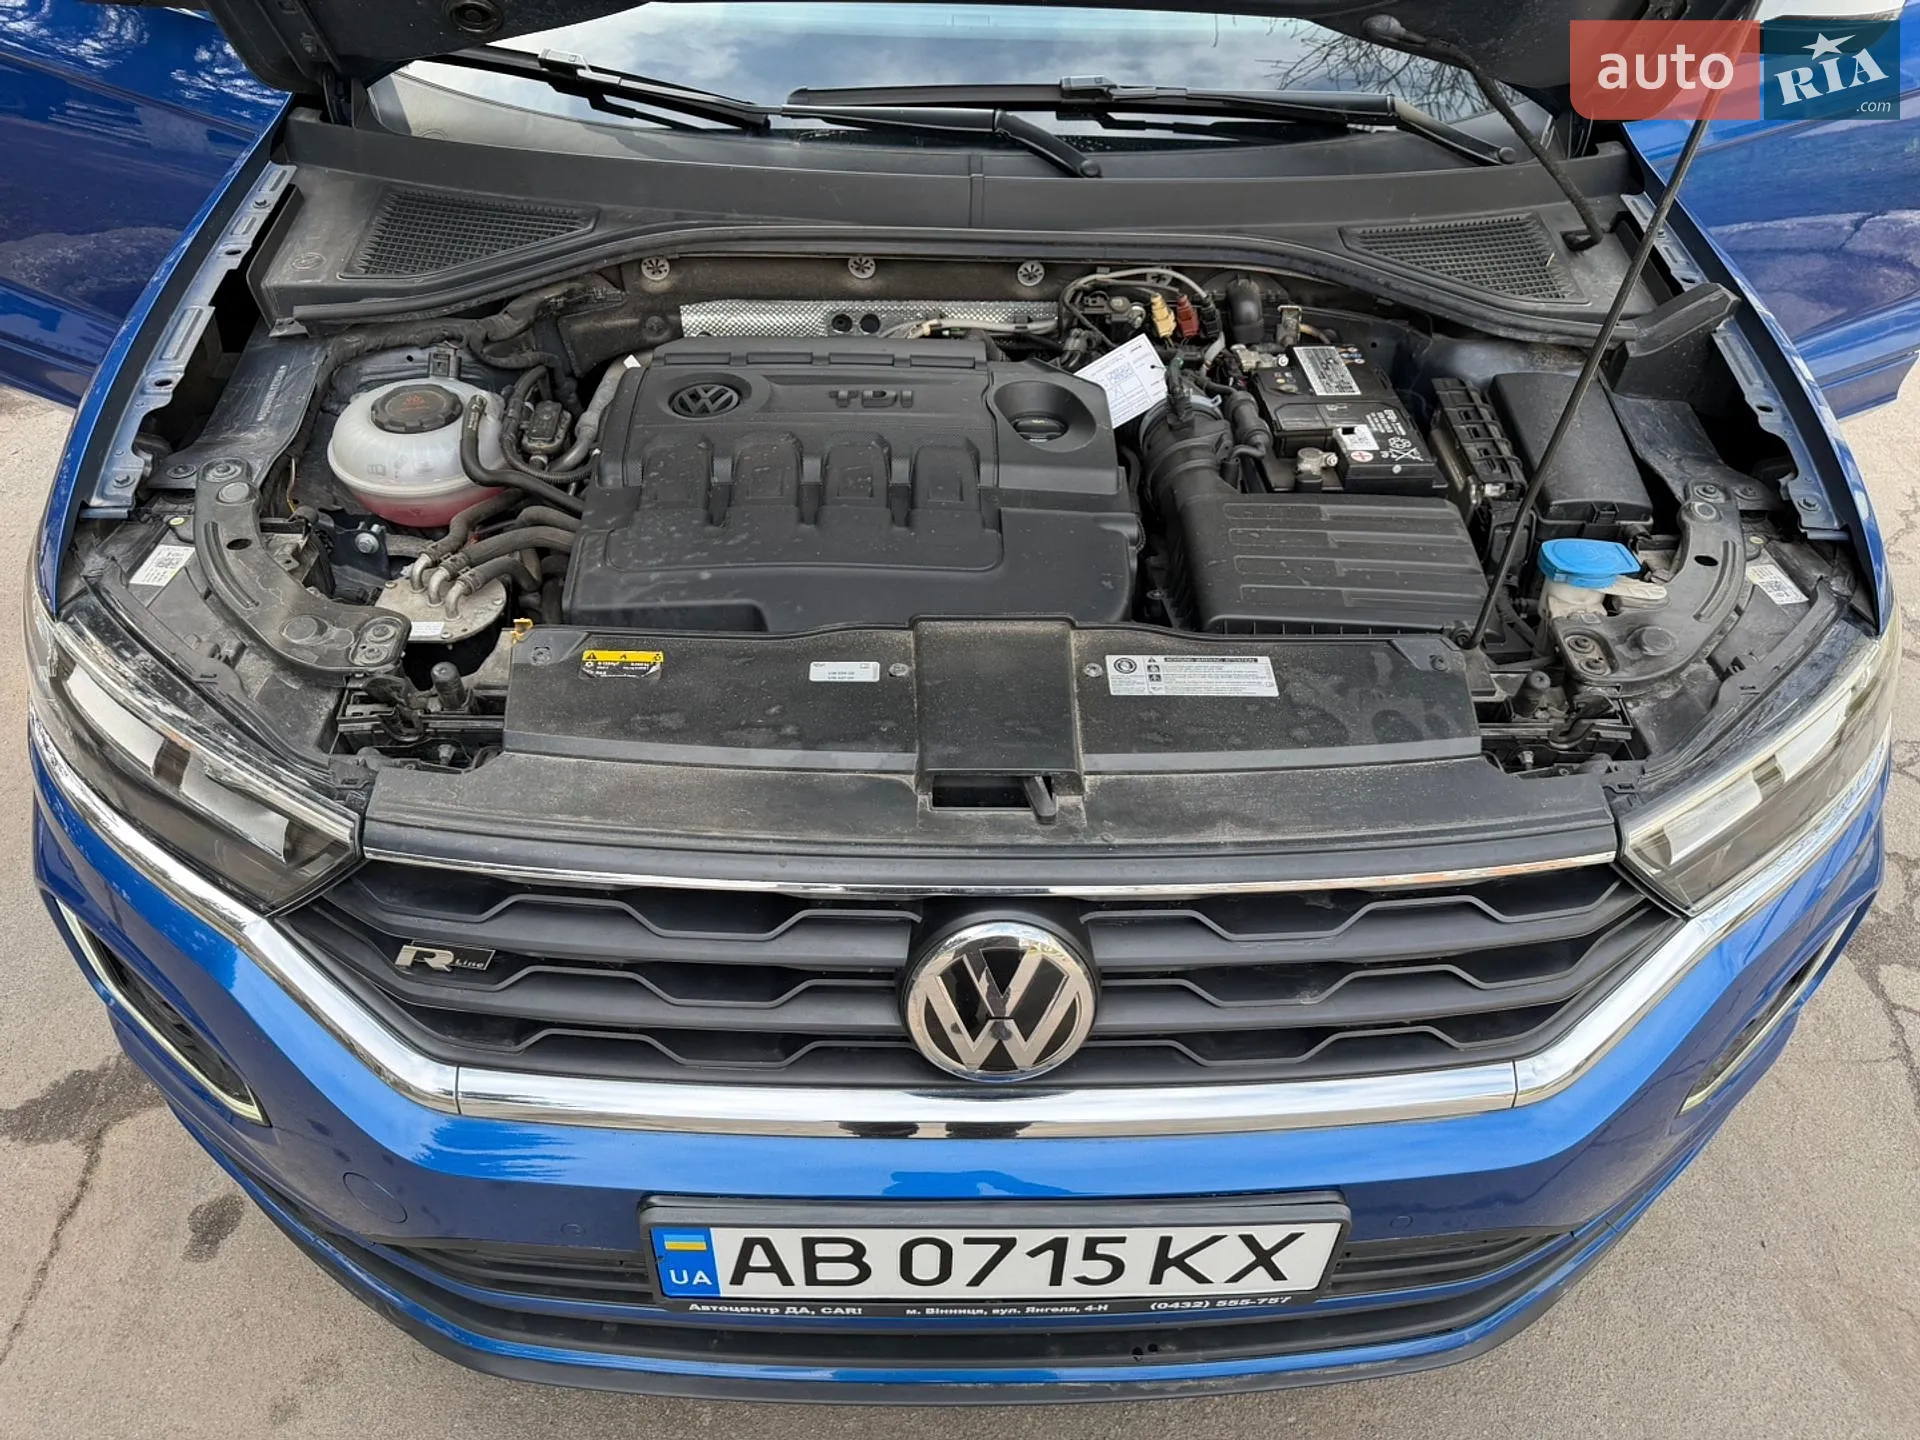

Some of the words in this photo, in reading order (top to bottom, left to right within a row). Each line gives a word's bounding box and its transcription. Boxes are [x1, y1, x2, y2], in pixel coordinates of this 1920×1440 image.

[828, 389, 914, 409] TDI
[395, 945, 454, 973] R
[730, 1236, 872, 1288] AB
[899, 1235, 1126, 1288] 0715
[1150, 1232, 1307, 1286] KX
[670, 1269, 712, 1288] UA
[689, 1303, 780, 1315] Автоцентр
[1150, 1300, 1210, 1311] (0432)
